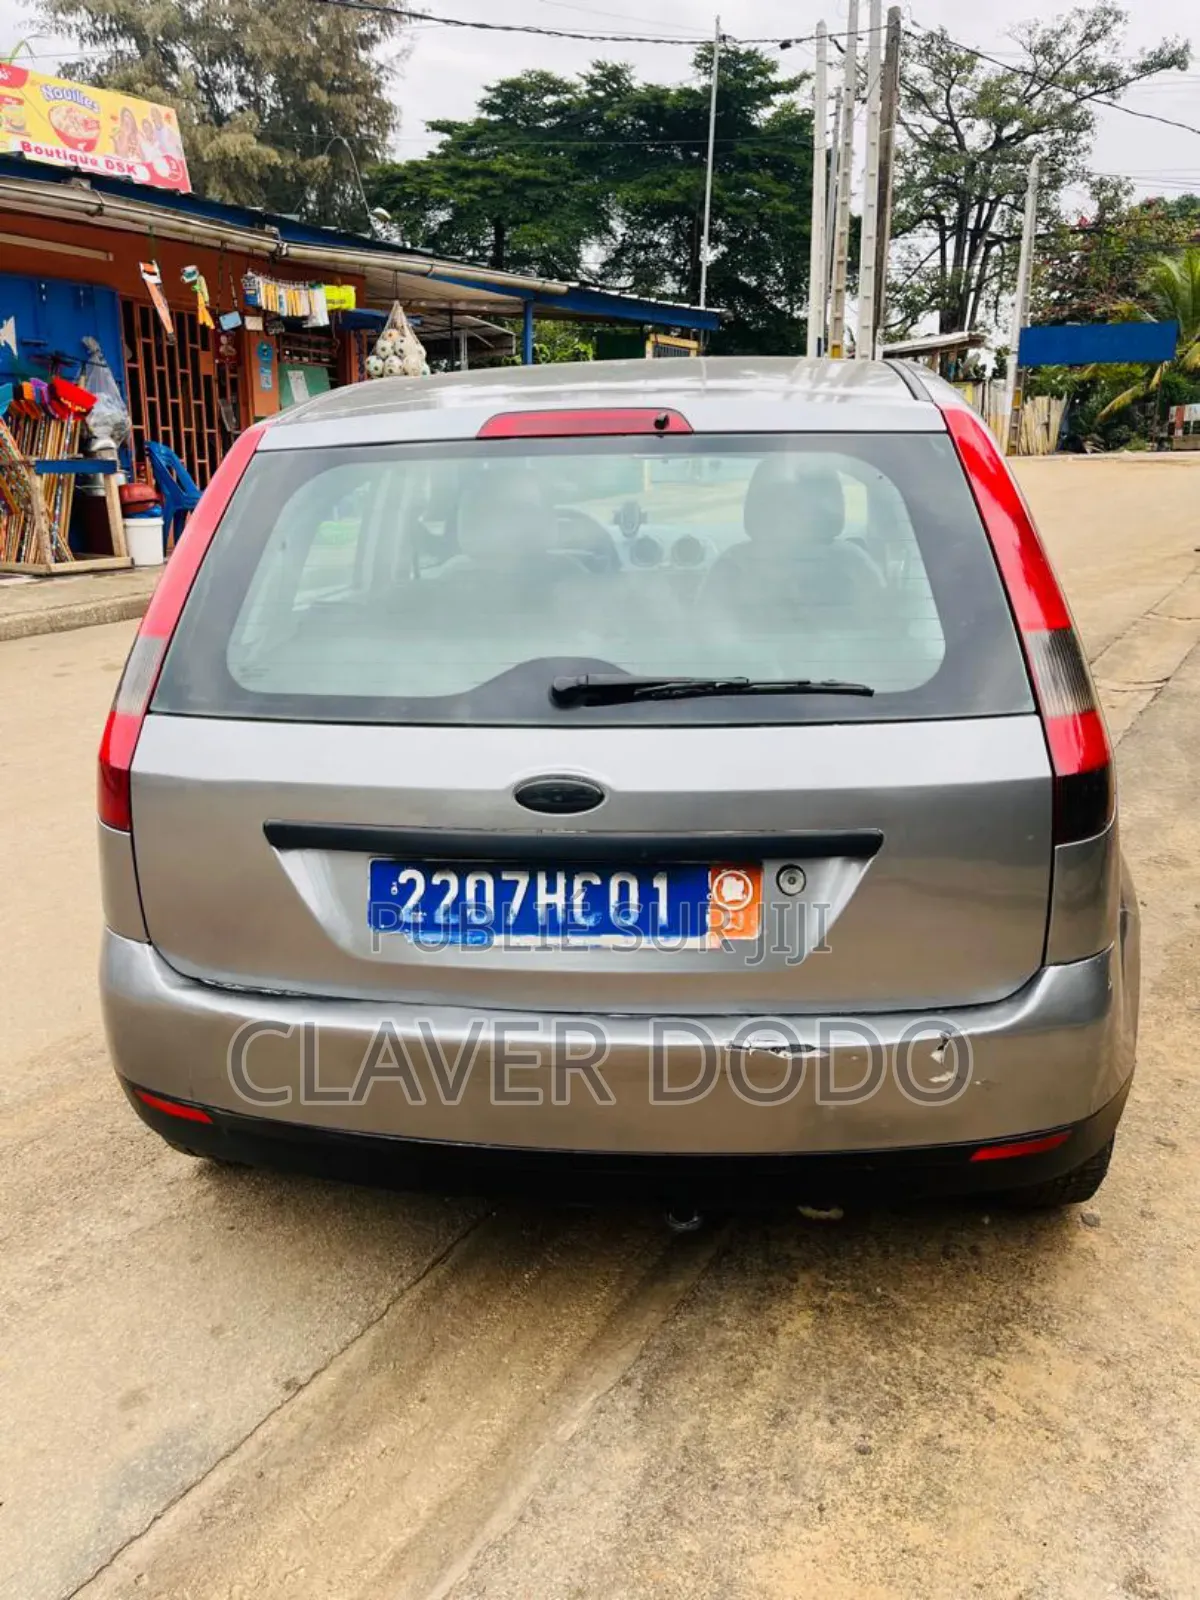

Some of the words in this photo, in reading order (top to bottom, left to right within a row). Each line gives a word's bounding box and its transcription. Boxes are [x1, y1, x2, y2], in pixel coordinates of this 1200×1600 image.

[20, 140, 98, 167] Boutique
[105, 159, 137, 175] DSK
[398, 868, 669, 927] 2207HC01
